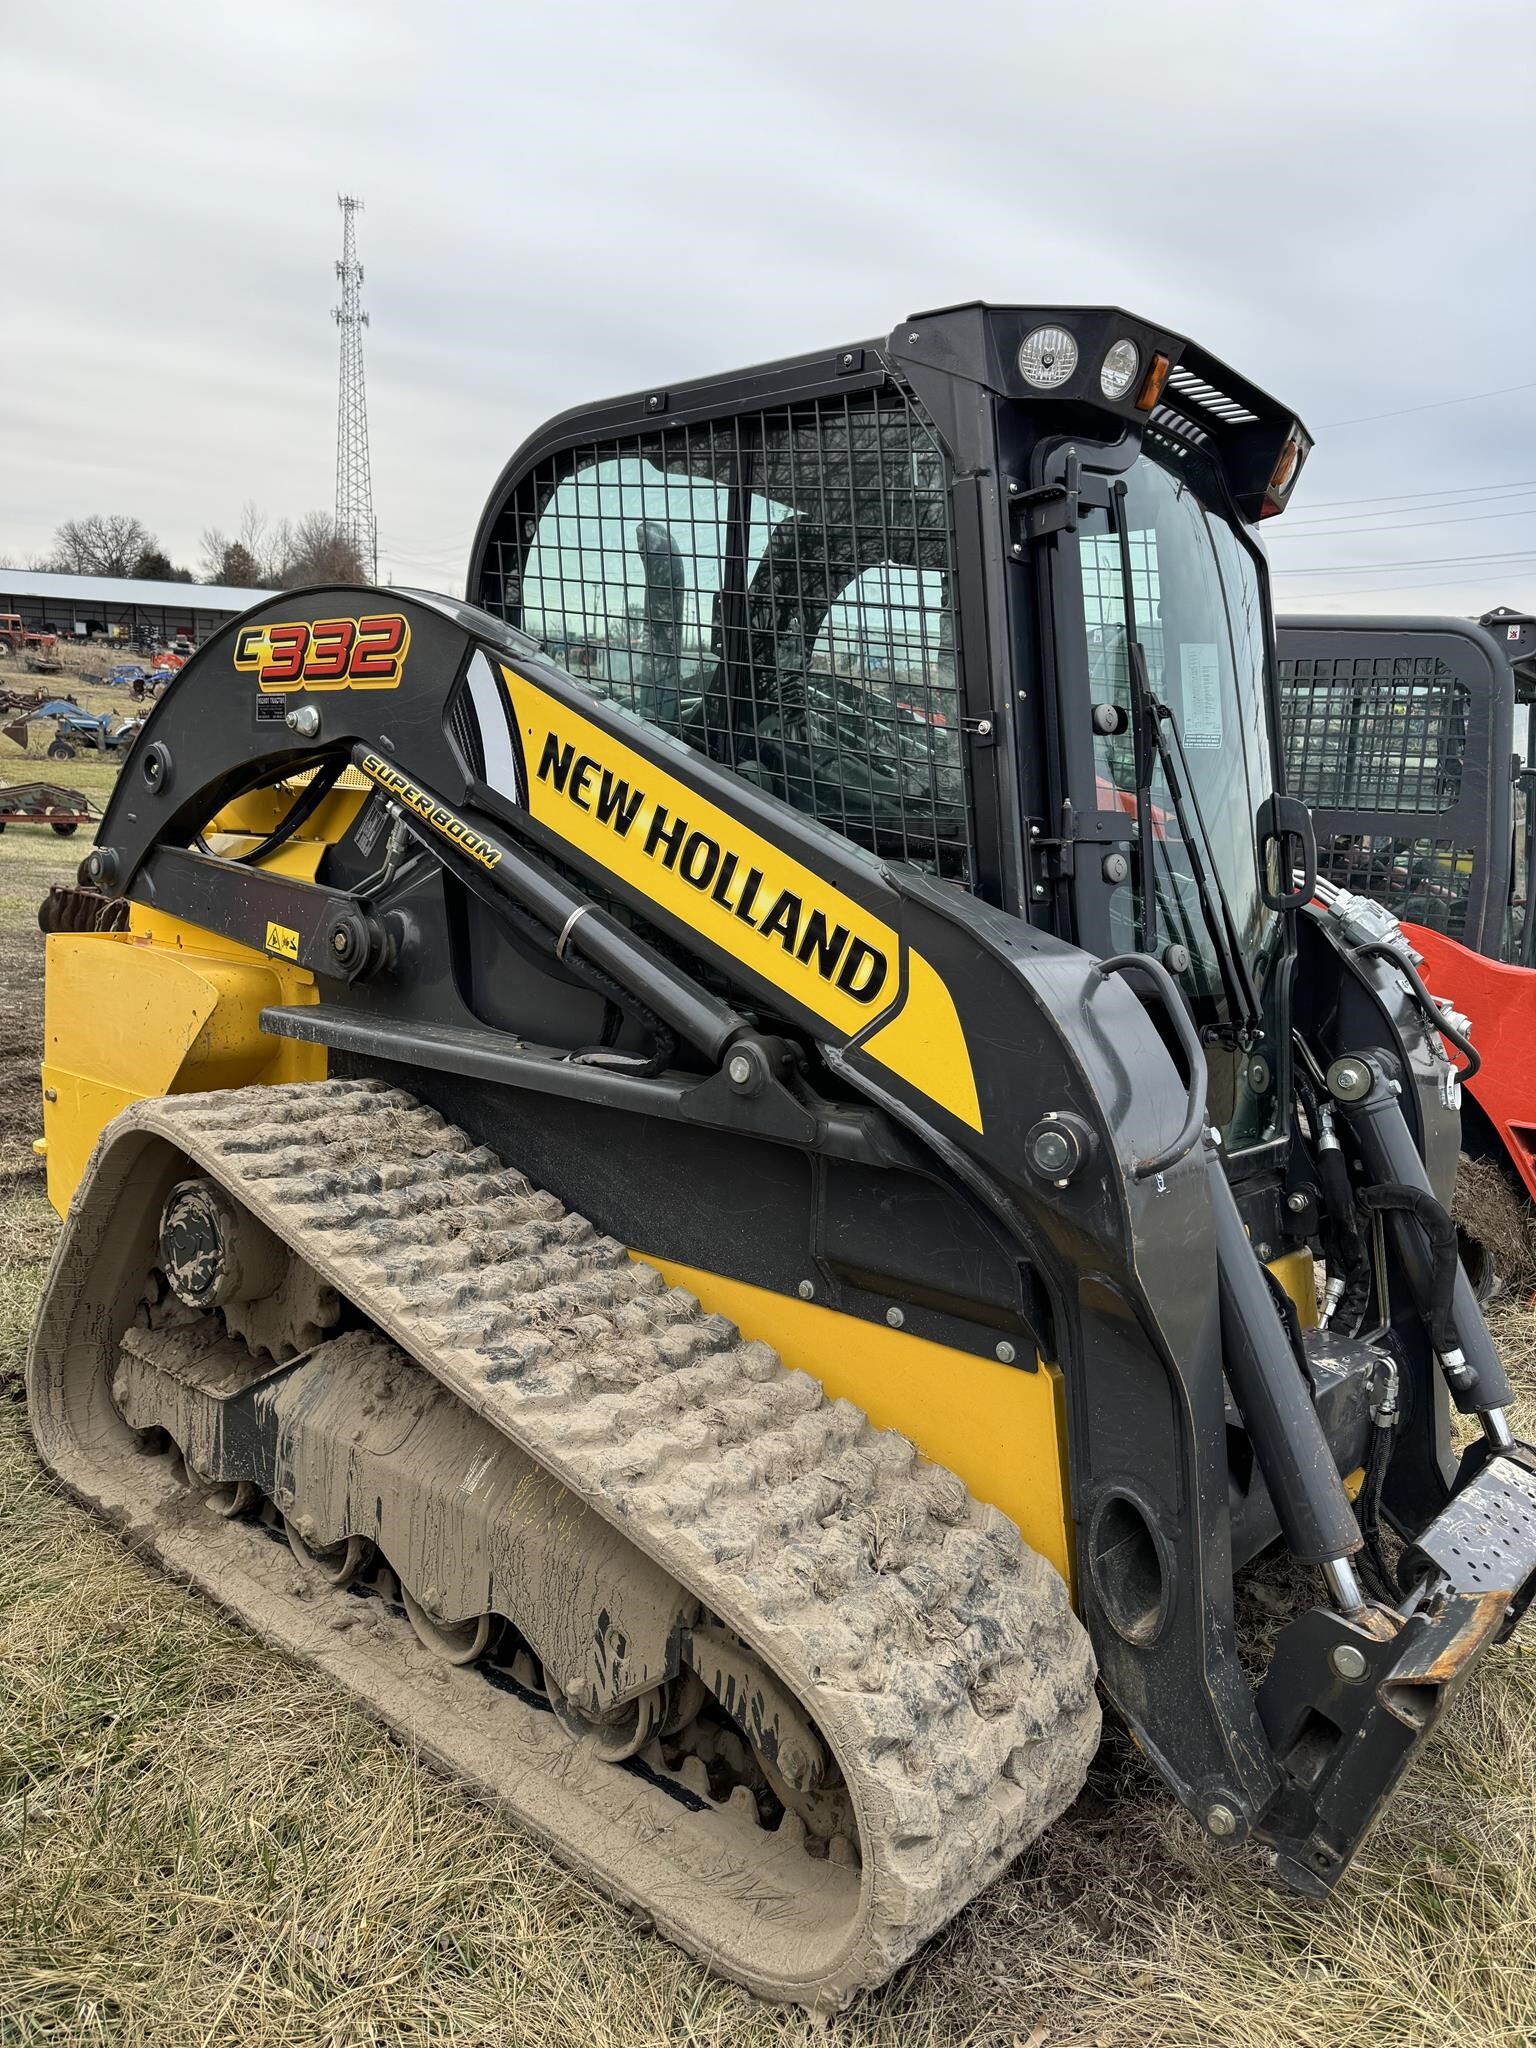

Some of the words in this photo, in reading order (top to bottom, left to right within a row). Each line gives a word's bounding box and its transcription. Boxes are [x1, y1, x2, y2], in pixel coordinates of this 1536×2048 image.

[234, 615, 409, 686] C332
[363, 755, 434, 817] SUPER
[431, 809, 502, 868] BOOM
[536, 731, 645, 838] NEW
[643, 804, 888, 1004] HOLLAND
